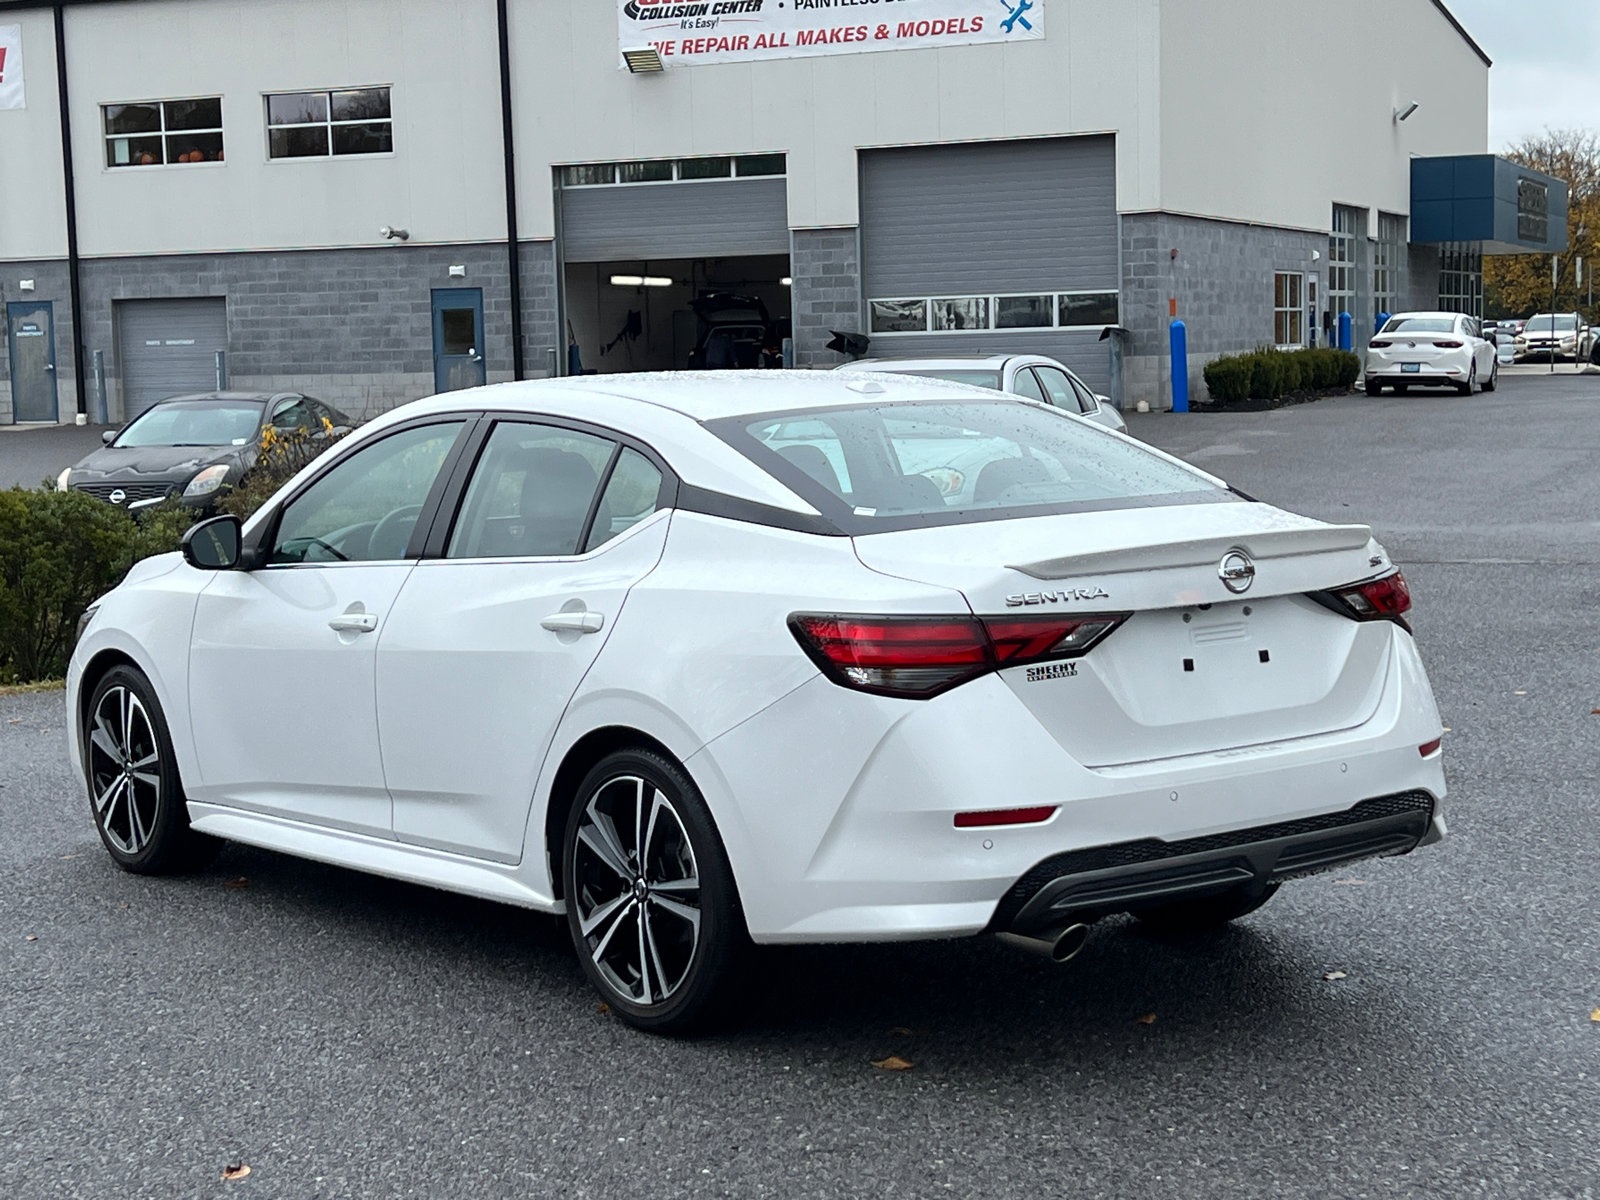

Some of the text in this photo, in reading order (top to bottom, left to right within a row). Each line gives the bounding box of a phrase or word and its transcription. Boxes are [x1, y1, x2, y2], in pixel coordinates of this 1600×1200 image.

[639, 0, 763, 20] COLLISION CENTER
[680, 17, 720, 30] It's Easy!
[680, 35, 750, 55] REPAIR
[753, 31, 790, 50] ALL
[795, 25, 868, 46] MAKES
[874, 24, 890, 40] &
[896, 16, 984, 38] MODELS
[1005, 586, 1109, 608] SENTRA
[1026, 662, 1076, 676] SHEEHY
